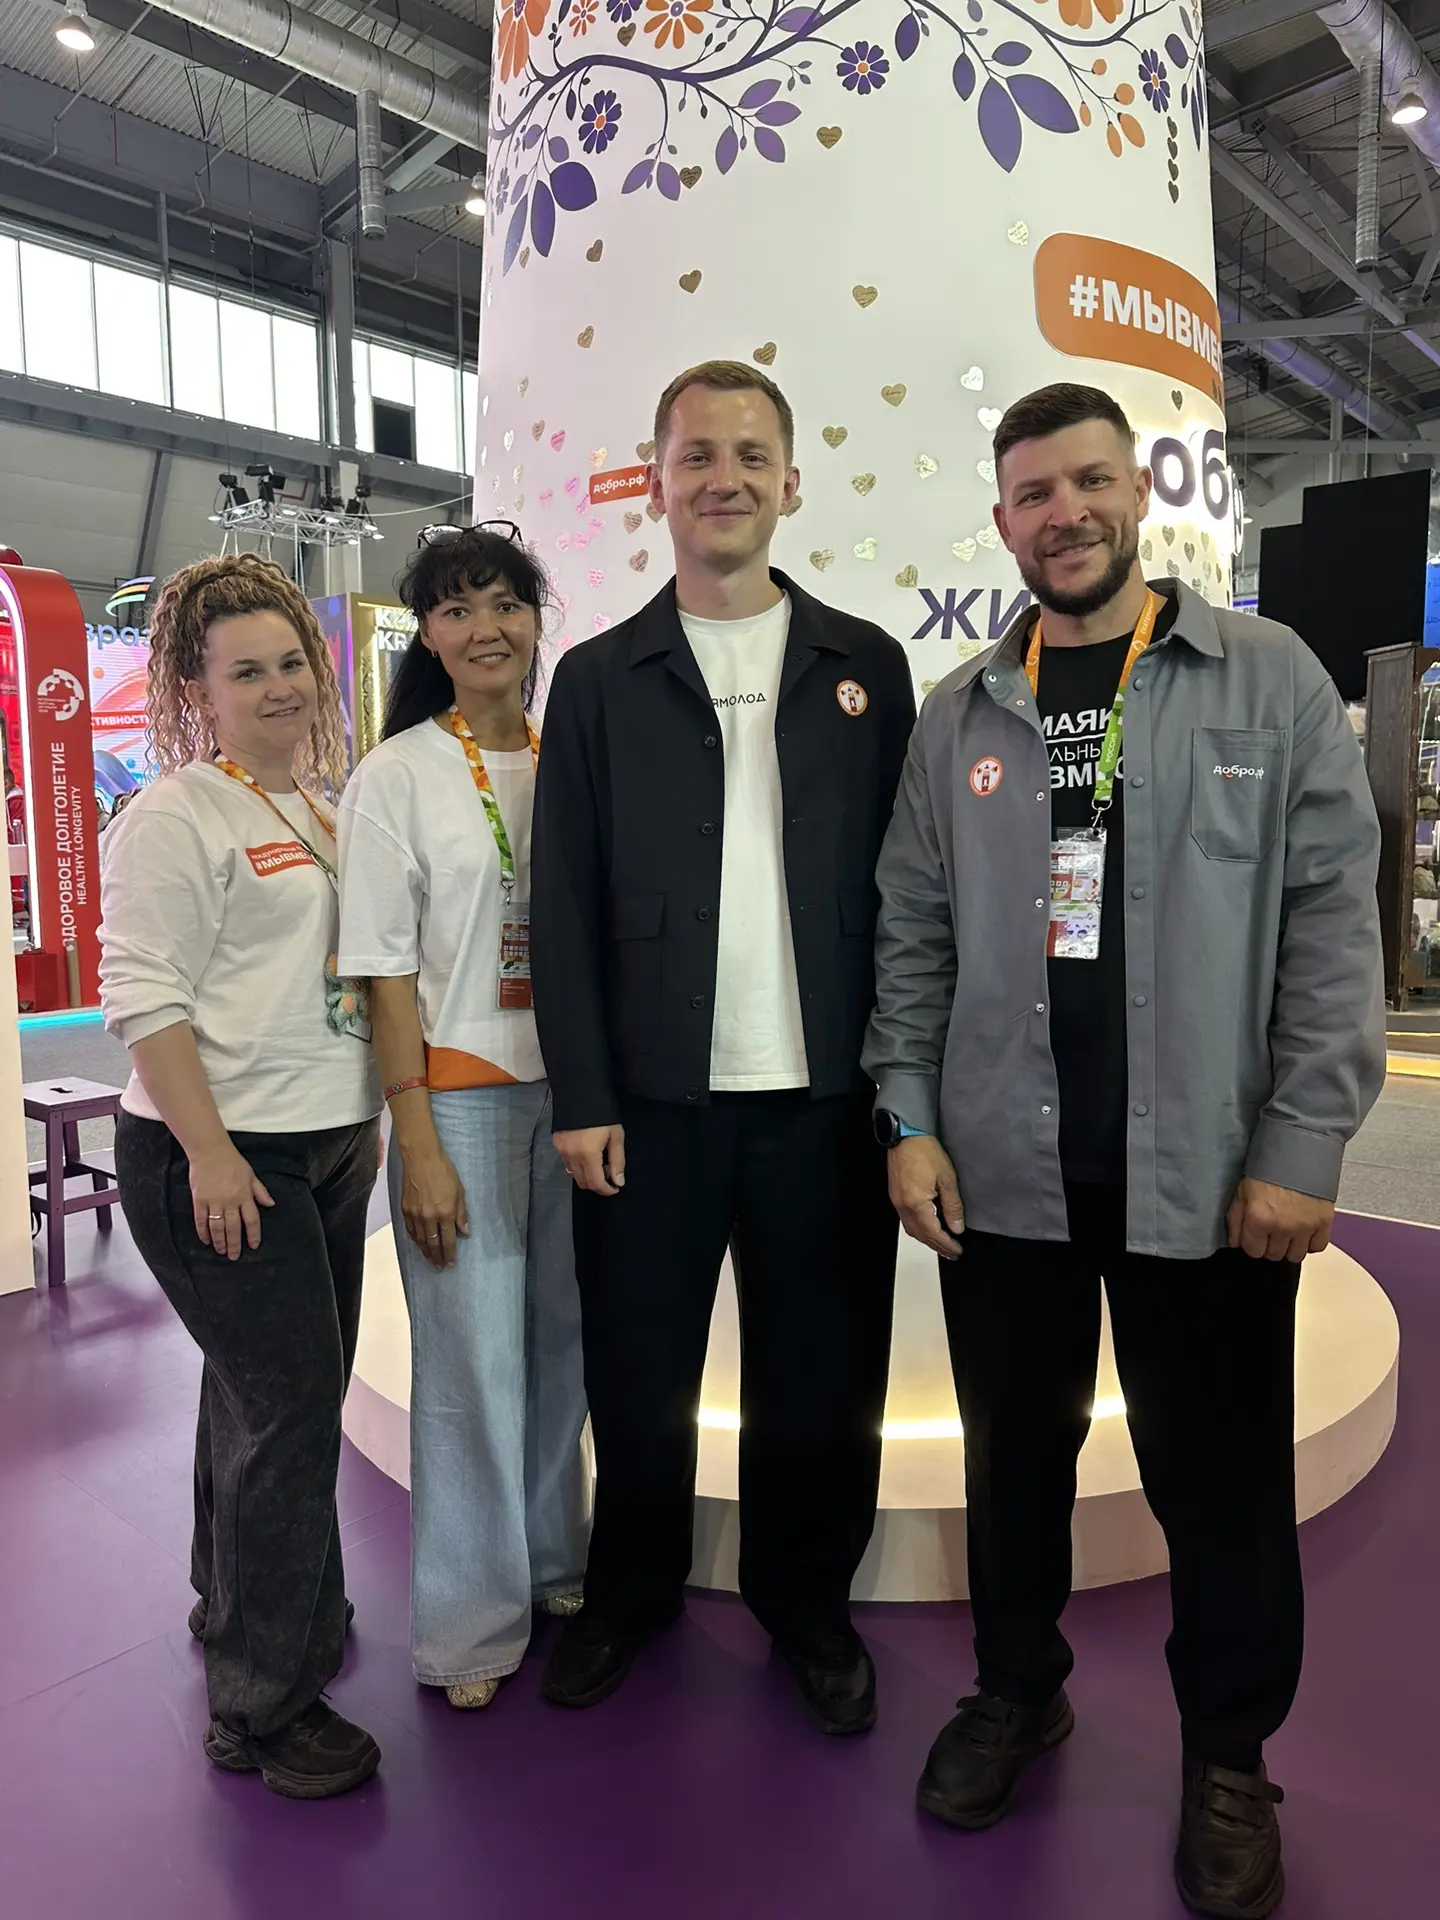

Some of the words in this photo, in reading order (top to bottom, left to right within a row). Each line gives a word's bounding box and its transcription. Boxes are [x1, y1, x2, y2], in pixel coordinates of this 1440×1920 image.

[593, 473, 645, 494] добро.рф
[51, 742, 73, 853] ДОЛГОЛЕТИЕ
[71, 786, 84, 850] LONGEVITY
[74, 853, 87, 905] HEALTHY
